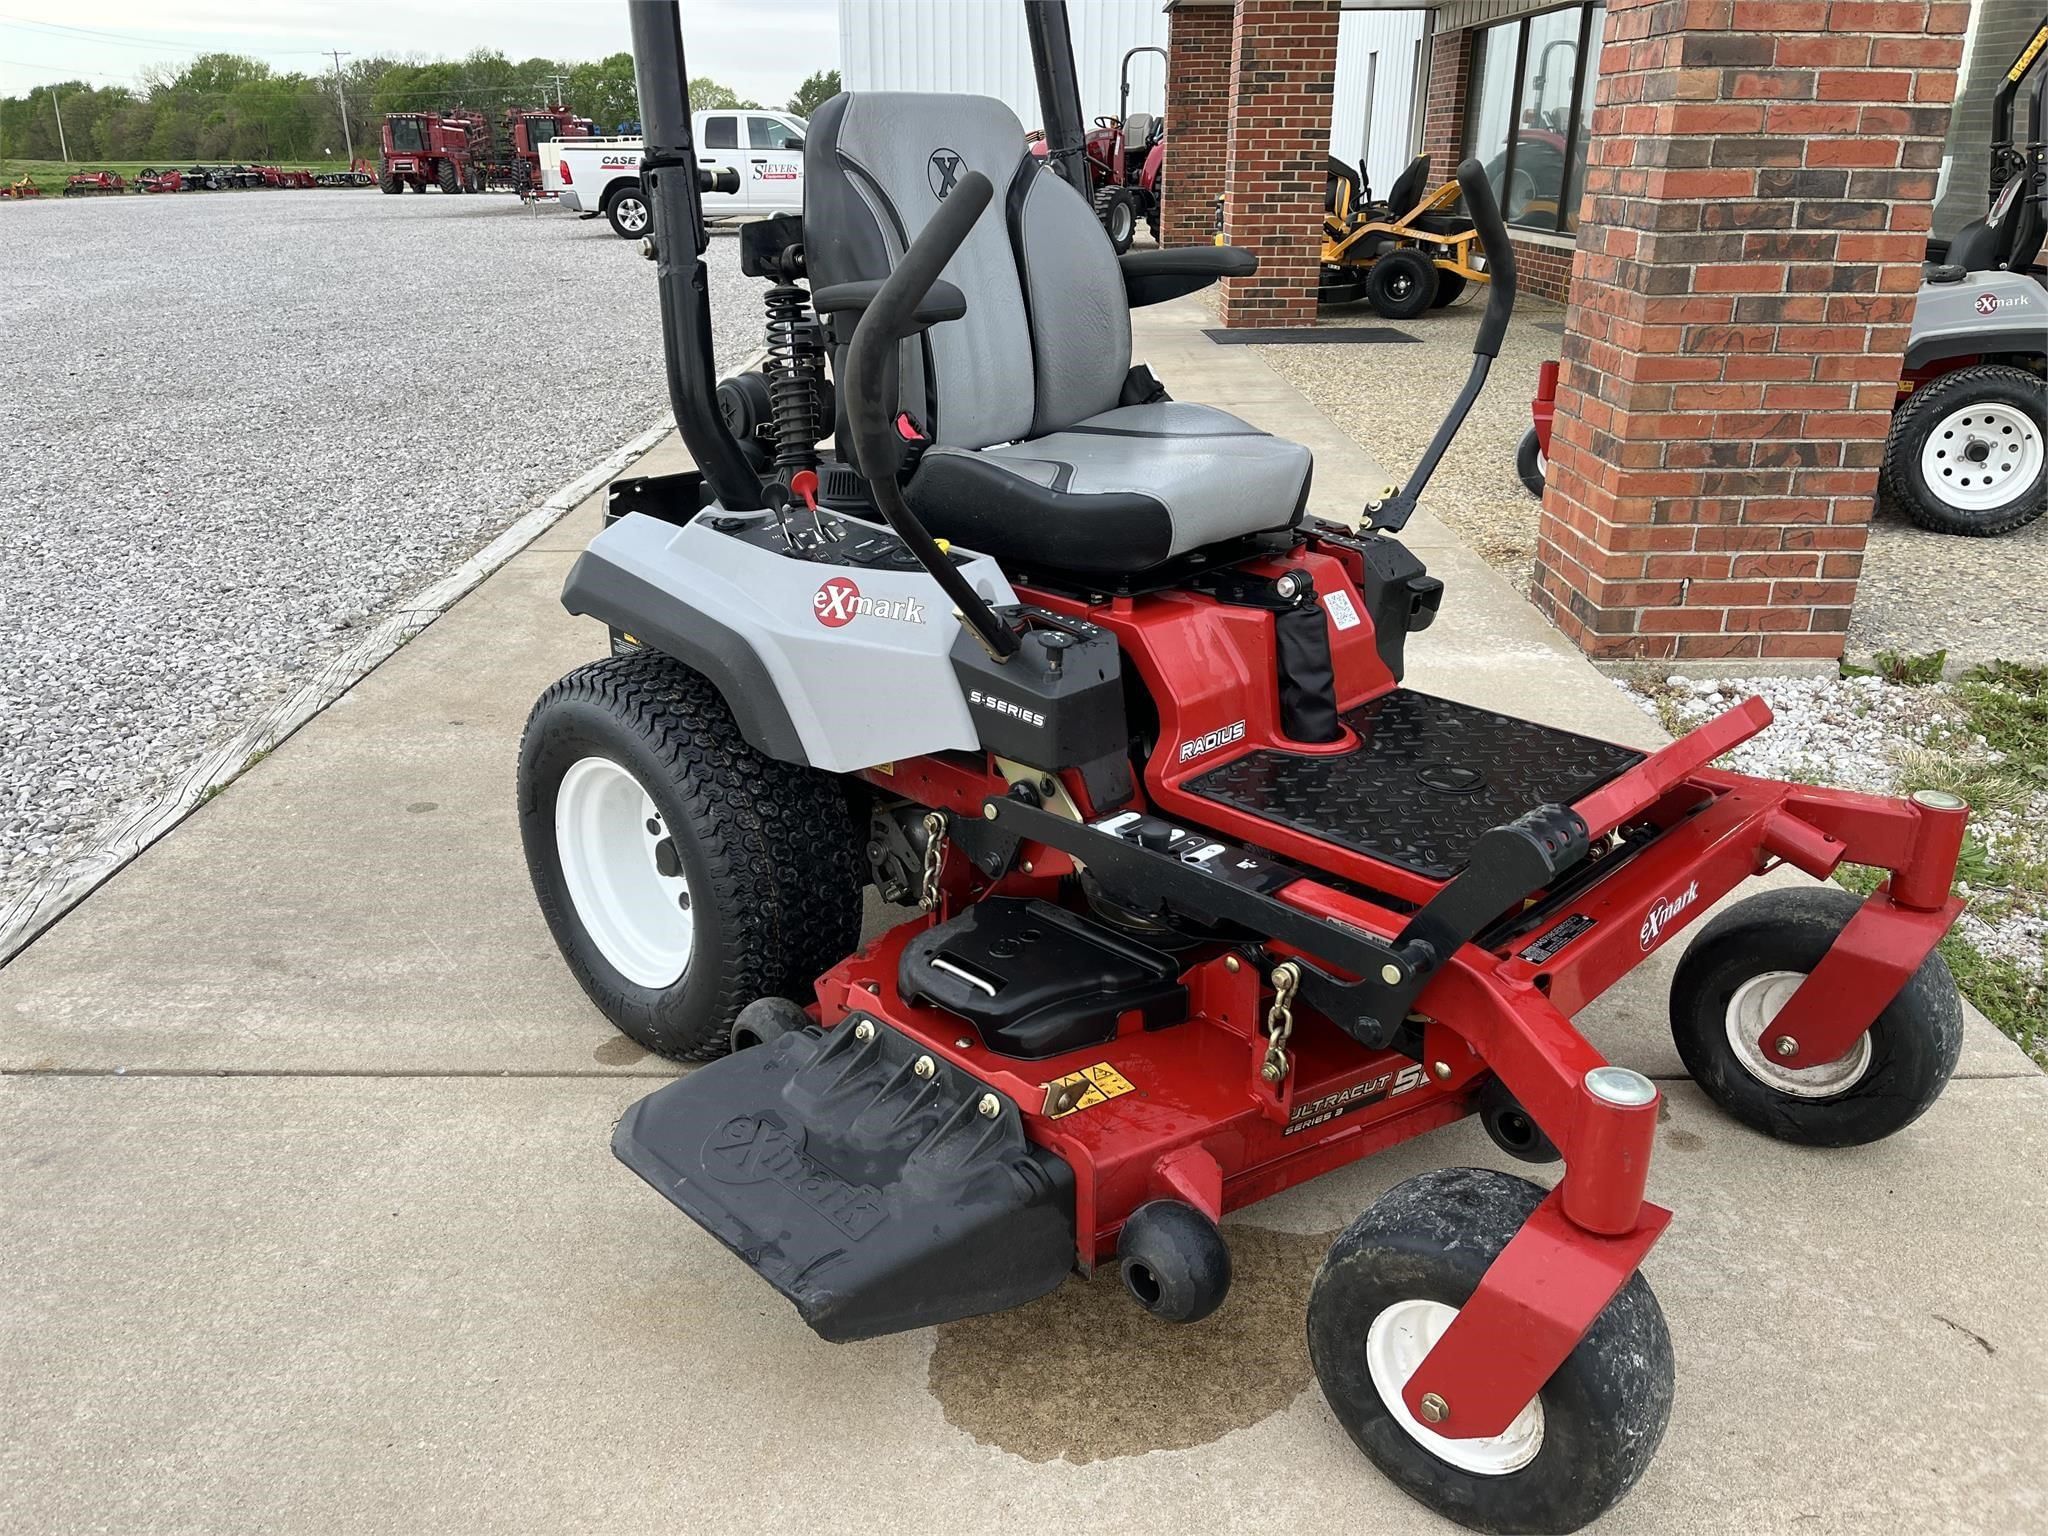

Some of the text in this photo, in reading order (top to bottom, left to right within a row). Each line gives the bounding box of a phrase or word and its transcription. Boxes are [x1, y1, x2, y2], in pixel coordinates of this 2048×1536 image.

[602, 156, 637, 165] CASE
[752, 163, 799, 180] SIEVERS
[1974, 295, 2029, 312] eXmark
[813, 584, 925, 624] eXmark
[969, 690, 1046, 728] S-SERIES
[1179, 720, 1246, 763] RADIUS
[1640, 880, 1699, 944] eXmark
[1284, 1107, 1345, 1136] SERIES 3
[714, 1112, 882, 1228] eXmark
